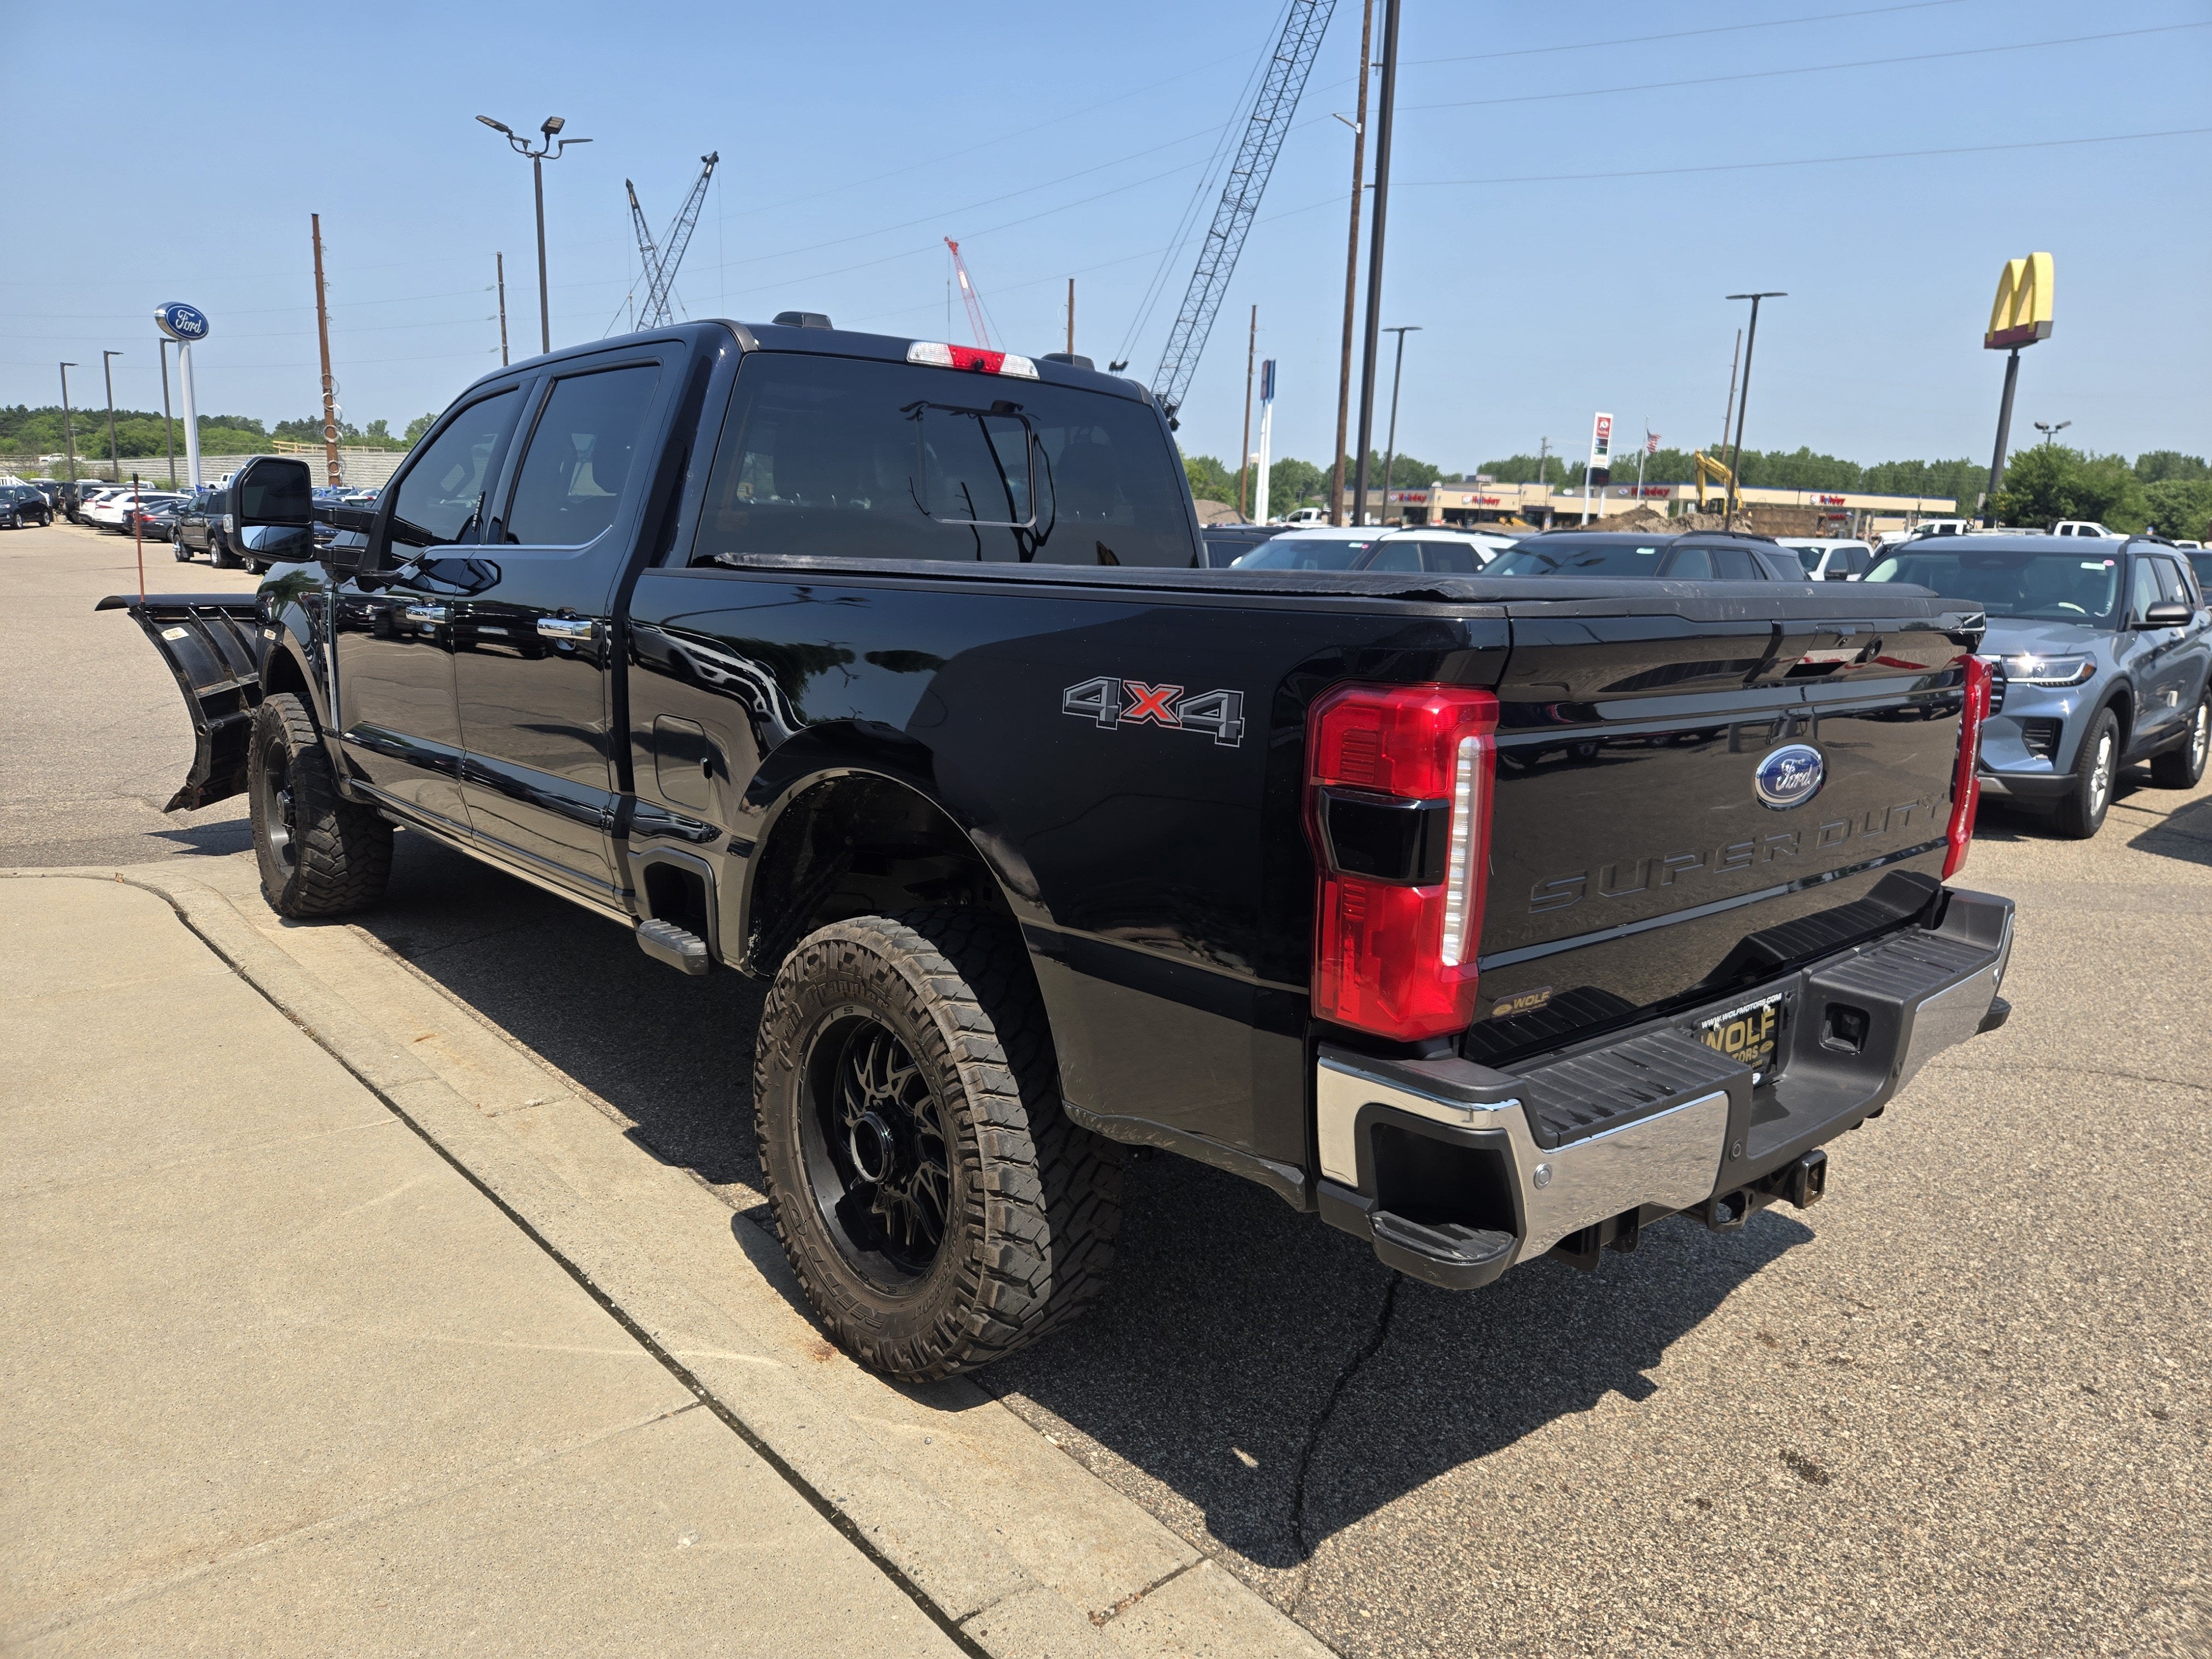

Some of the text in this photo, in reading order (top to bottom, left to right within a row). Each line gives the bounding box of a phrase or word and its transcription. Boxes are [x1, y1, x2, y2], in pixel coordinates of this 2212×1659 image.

[175, 309, 202, 333] Ford
[1775, 758, 1813, 791] Ford
[1528, 792, 1945, 914] SUPER DUTY
[1513, 990, 1550, 1009] WOLF
[1702, 992, 1782, 1029] WWW.WOLFMOTORS.COM
